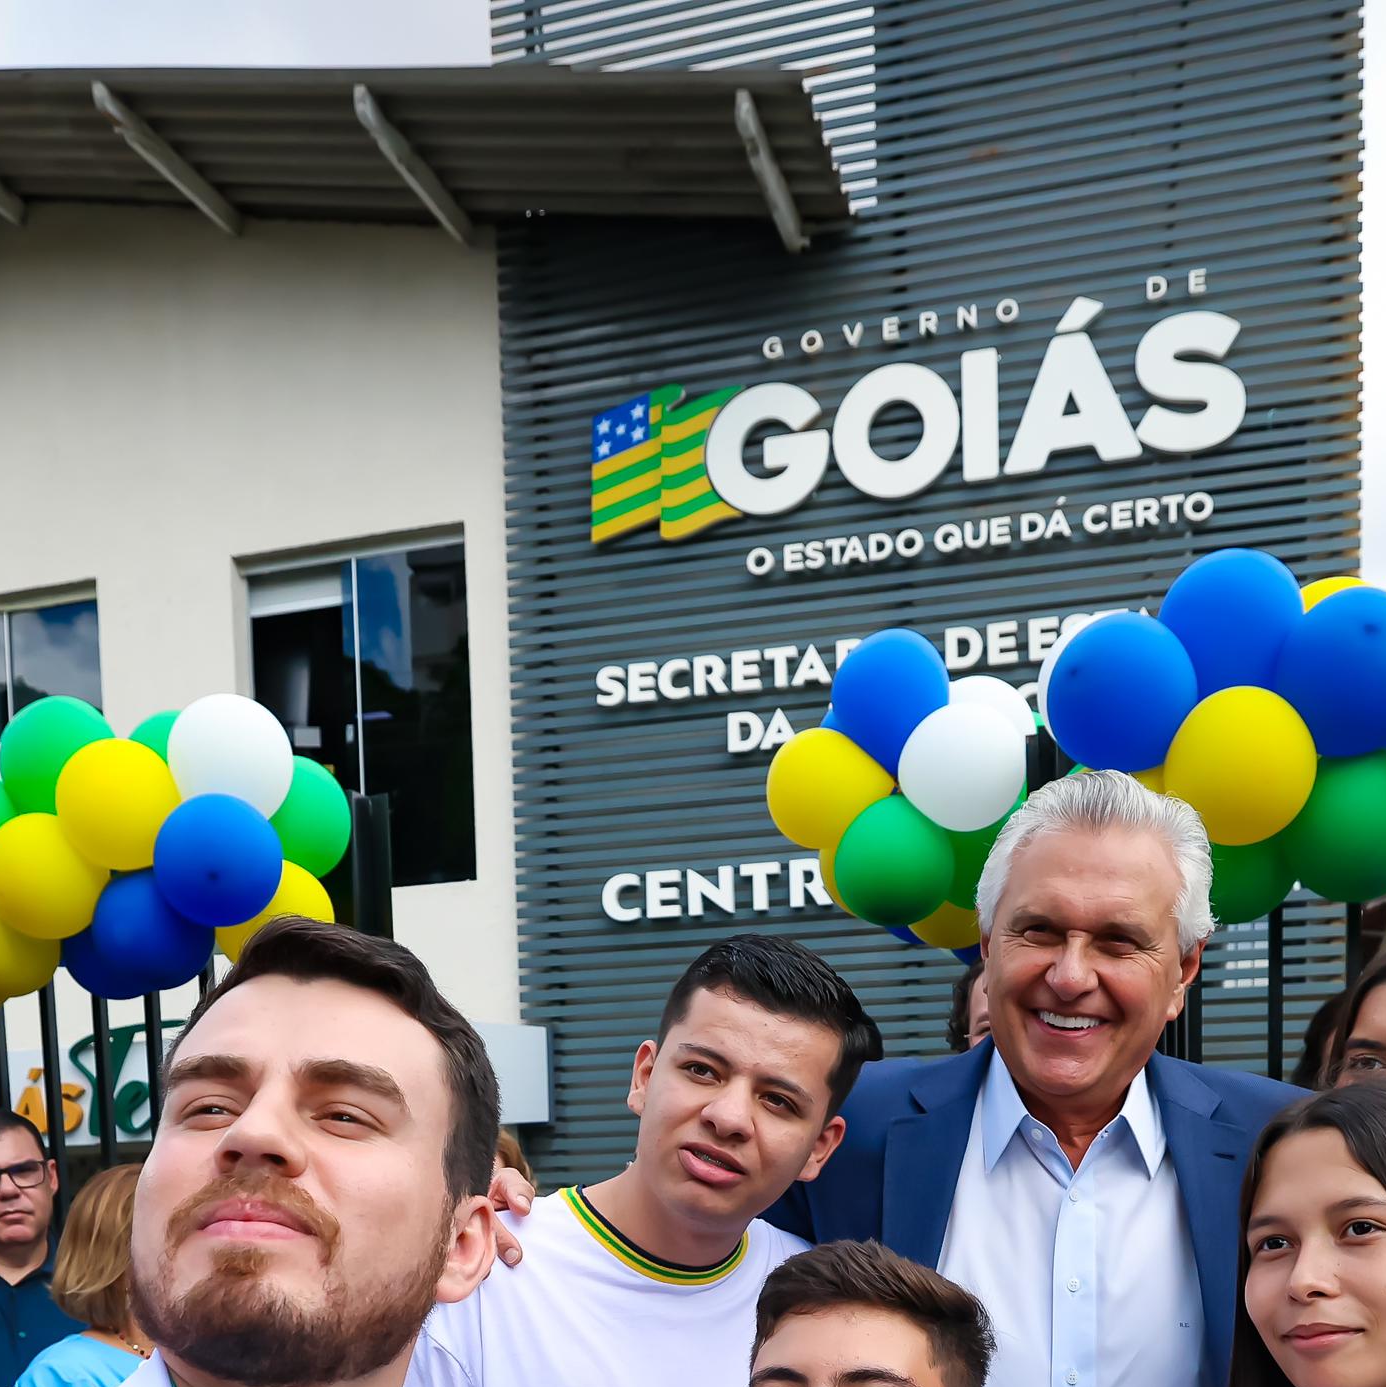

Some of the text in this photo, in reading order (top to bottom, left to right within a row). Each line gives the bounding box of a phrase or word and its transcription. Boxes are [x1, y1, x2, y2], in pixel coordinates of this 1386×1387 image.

[763, 268, 1208, 360] GOVERNO DE
[704, 295, 1247, 516] GOIÁS
[746, 491, 1215, 576] O ESTADO QUE DÁ CERTO
[944, 619, 1019, 670] DE
[727, 707, 796, 754] DA
